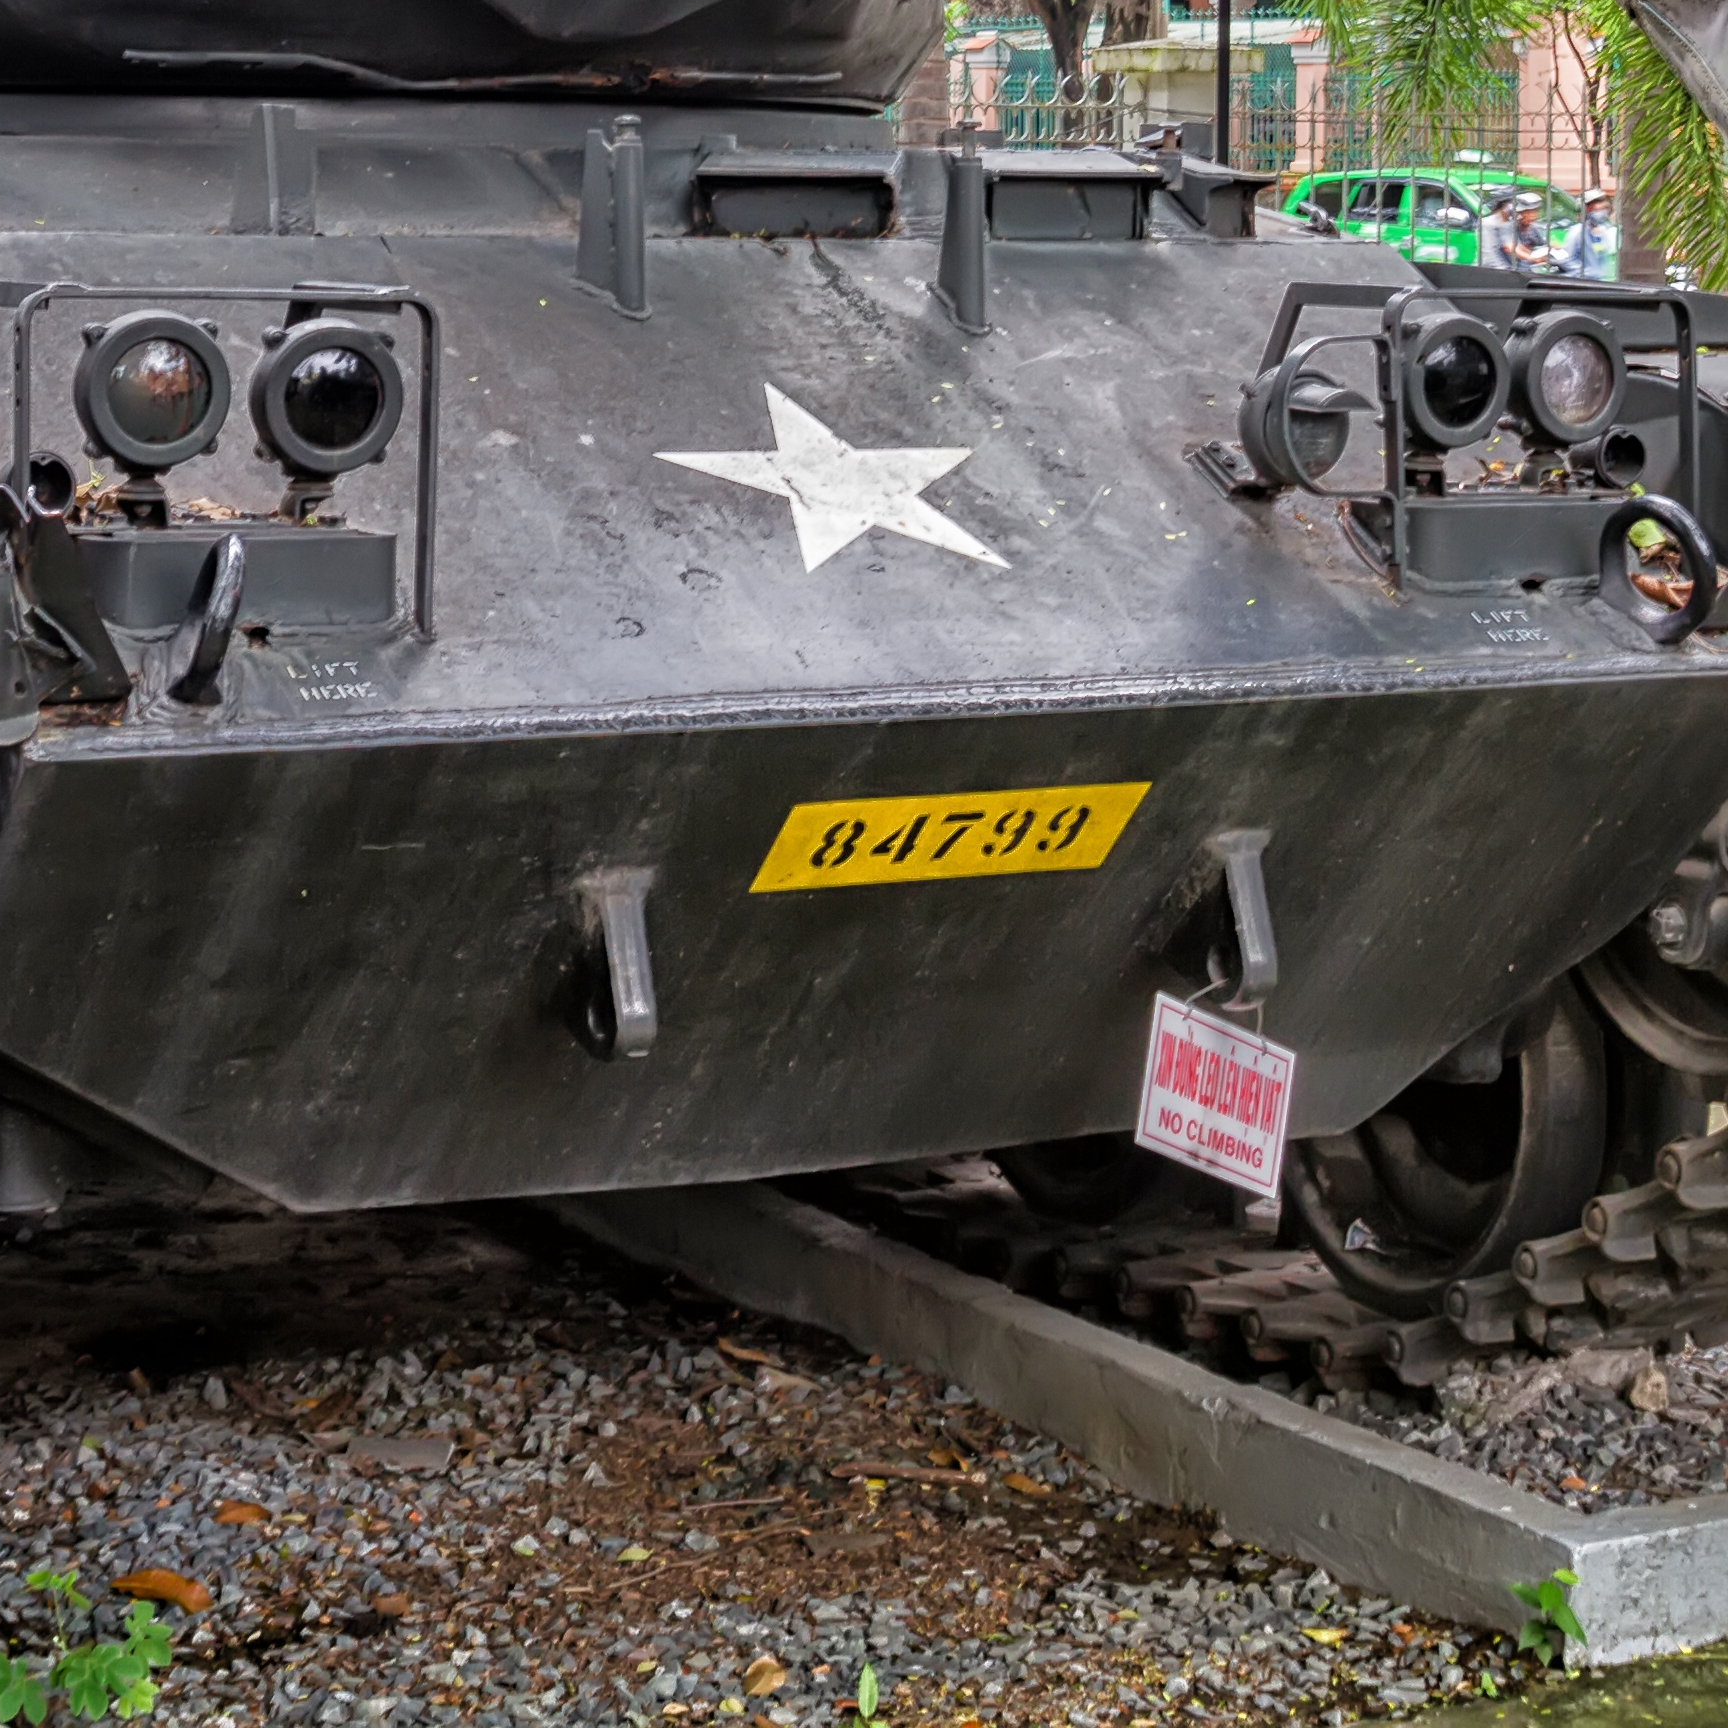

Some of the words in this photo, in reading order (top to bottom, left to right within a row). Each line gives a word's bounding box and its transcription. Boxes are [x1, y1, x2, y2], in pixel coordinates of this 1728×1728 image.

[1470, 609, 1530, 624] LIFT
[1486, 627, 1550, 642] HERE
[286, 661, 358, 679] LIFT
[299, 681, 378, 701] HERE
[809, 803, 1093, 870] 84799
[1158, 1107, 1183, 1135] NO
[1186, 1120, 1263, 1169] CLIMBING
